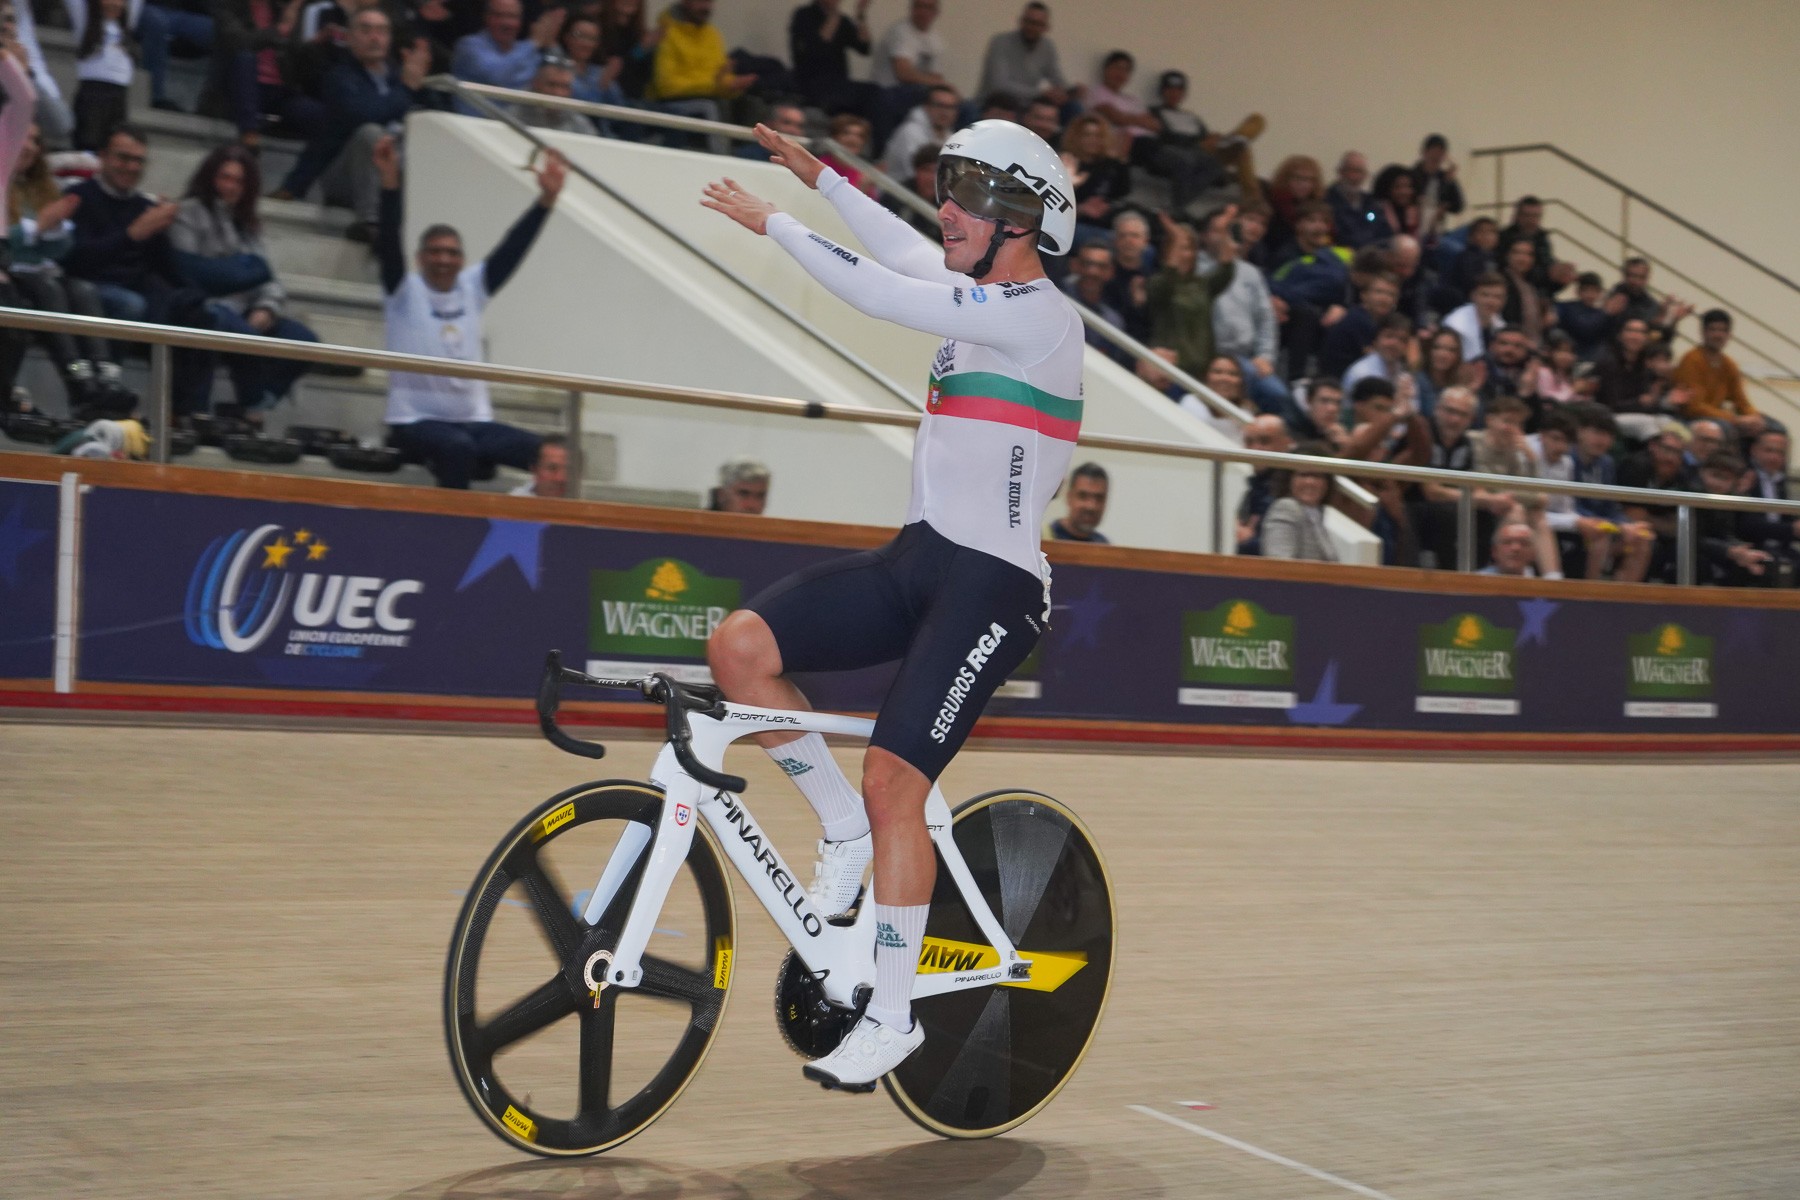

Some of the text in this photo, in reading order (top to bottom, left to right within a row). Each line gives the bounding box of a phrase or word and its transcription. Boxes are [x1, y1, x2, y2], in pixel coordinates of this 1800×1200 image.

[1004, 162, 1074, 214] MET
[831, 247, 859, 266] RGA
[1002, 284, 1040, 299] UROS
[1008, 445, 1025, 529] CAJA RURAL
[293, 572, 425, 632] UEC
[602, 599, 727, 640] WAGNER
[288, 629, 328, 643] UNION
[1190, 636, 1290, 671] WAGNER
[1424, 648, 1513, 679] WAGNER
[930, 621, 1009, 744] SEGUROS RGA
[1631, 656, 1711, 685] WAGNER
[730, 712, 802, 725] PORTUGAL
[546, 807, 573, 830] MAVIC
[713, 789, 823, 938] PINARELLO
[718, 952, 729, 988] MAVIC
[918, 943, 985, 972] MAV
[954, 971, 1002, 983] PINARELLO
[504, 1111, 530, 1132] MAVIC
